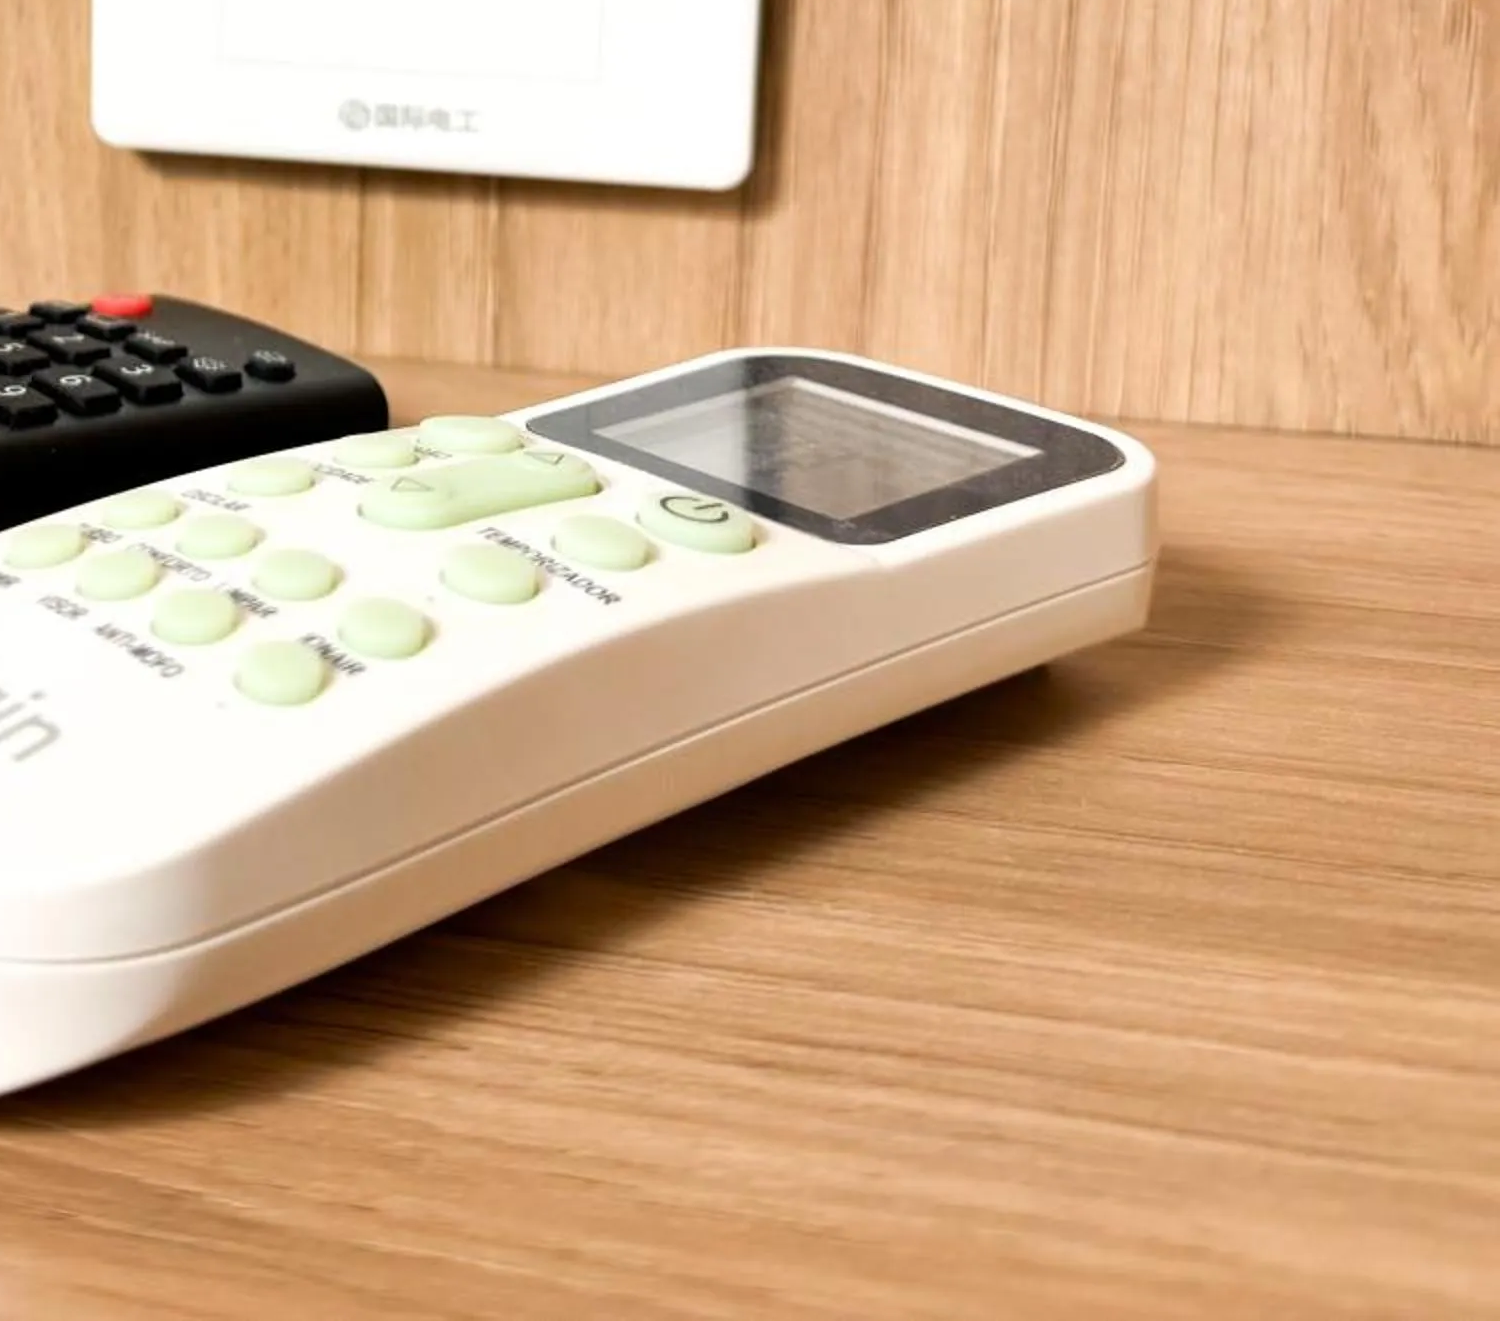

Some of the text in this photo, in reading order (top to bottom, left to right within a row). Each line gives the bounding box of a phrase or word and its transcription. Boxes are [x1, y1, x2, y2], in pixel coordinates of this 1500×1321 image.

[121, 362, 155, 376] 3
[59, 374, 92, 387] 6
[477, 526, 621, 605] TEMPORIZADOR
